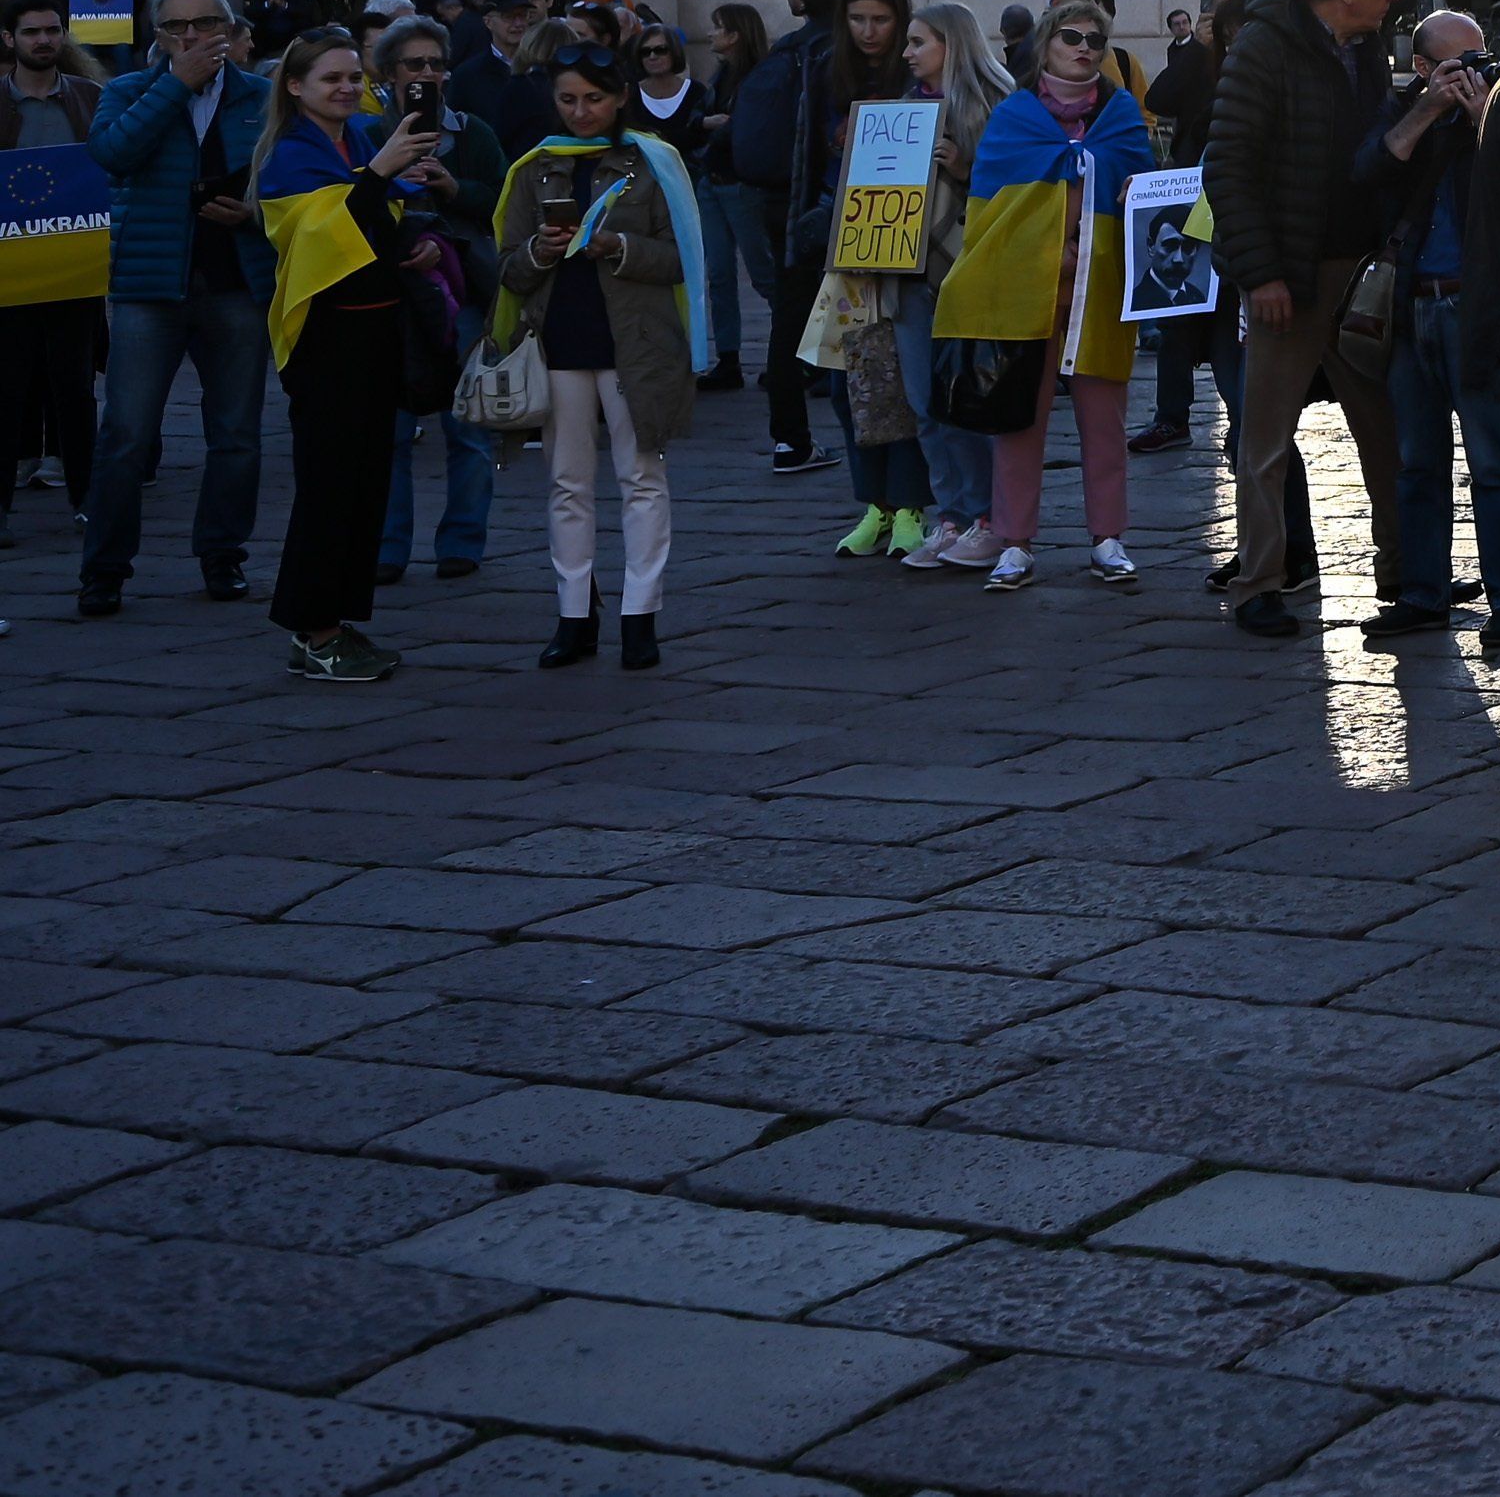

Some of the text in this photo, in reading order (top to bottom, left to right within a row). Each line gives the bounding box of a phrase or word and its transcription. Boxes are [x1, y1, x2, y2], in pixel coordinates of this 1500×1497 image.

[861, 111, 924, 146] PACE
[1131, 189, 1172, 201] CRIMINALE
[1173, 188, 1183, 196] DI
[1149, 175, 1199, 189] STOP PUTLER
[845, 188, 924, 225] STOP
[25, 211, 111, 235] UKRAIN
[839, 224, 919, 263] PUTIN
